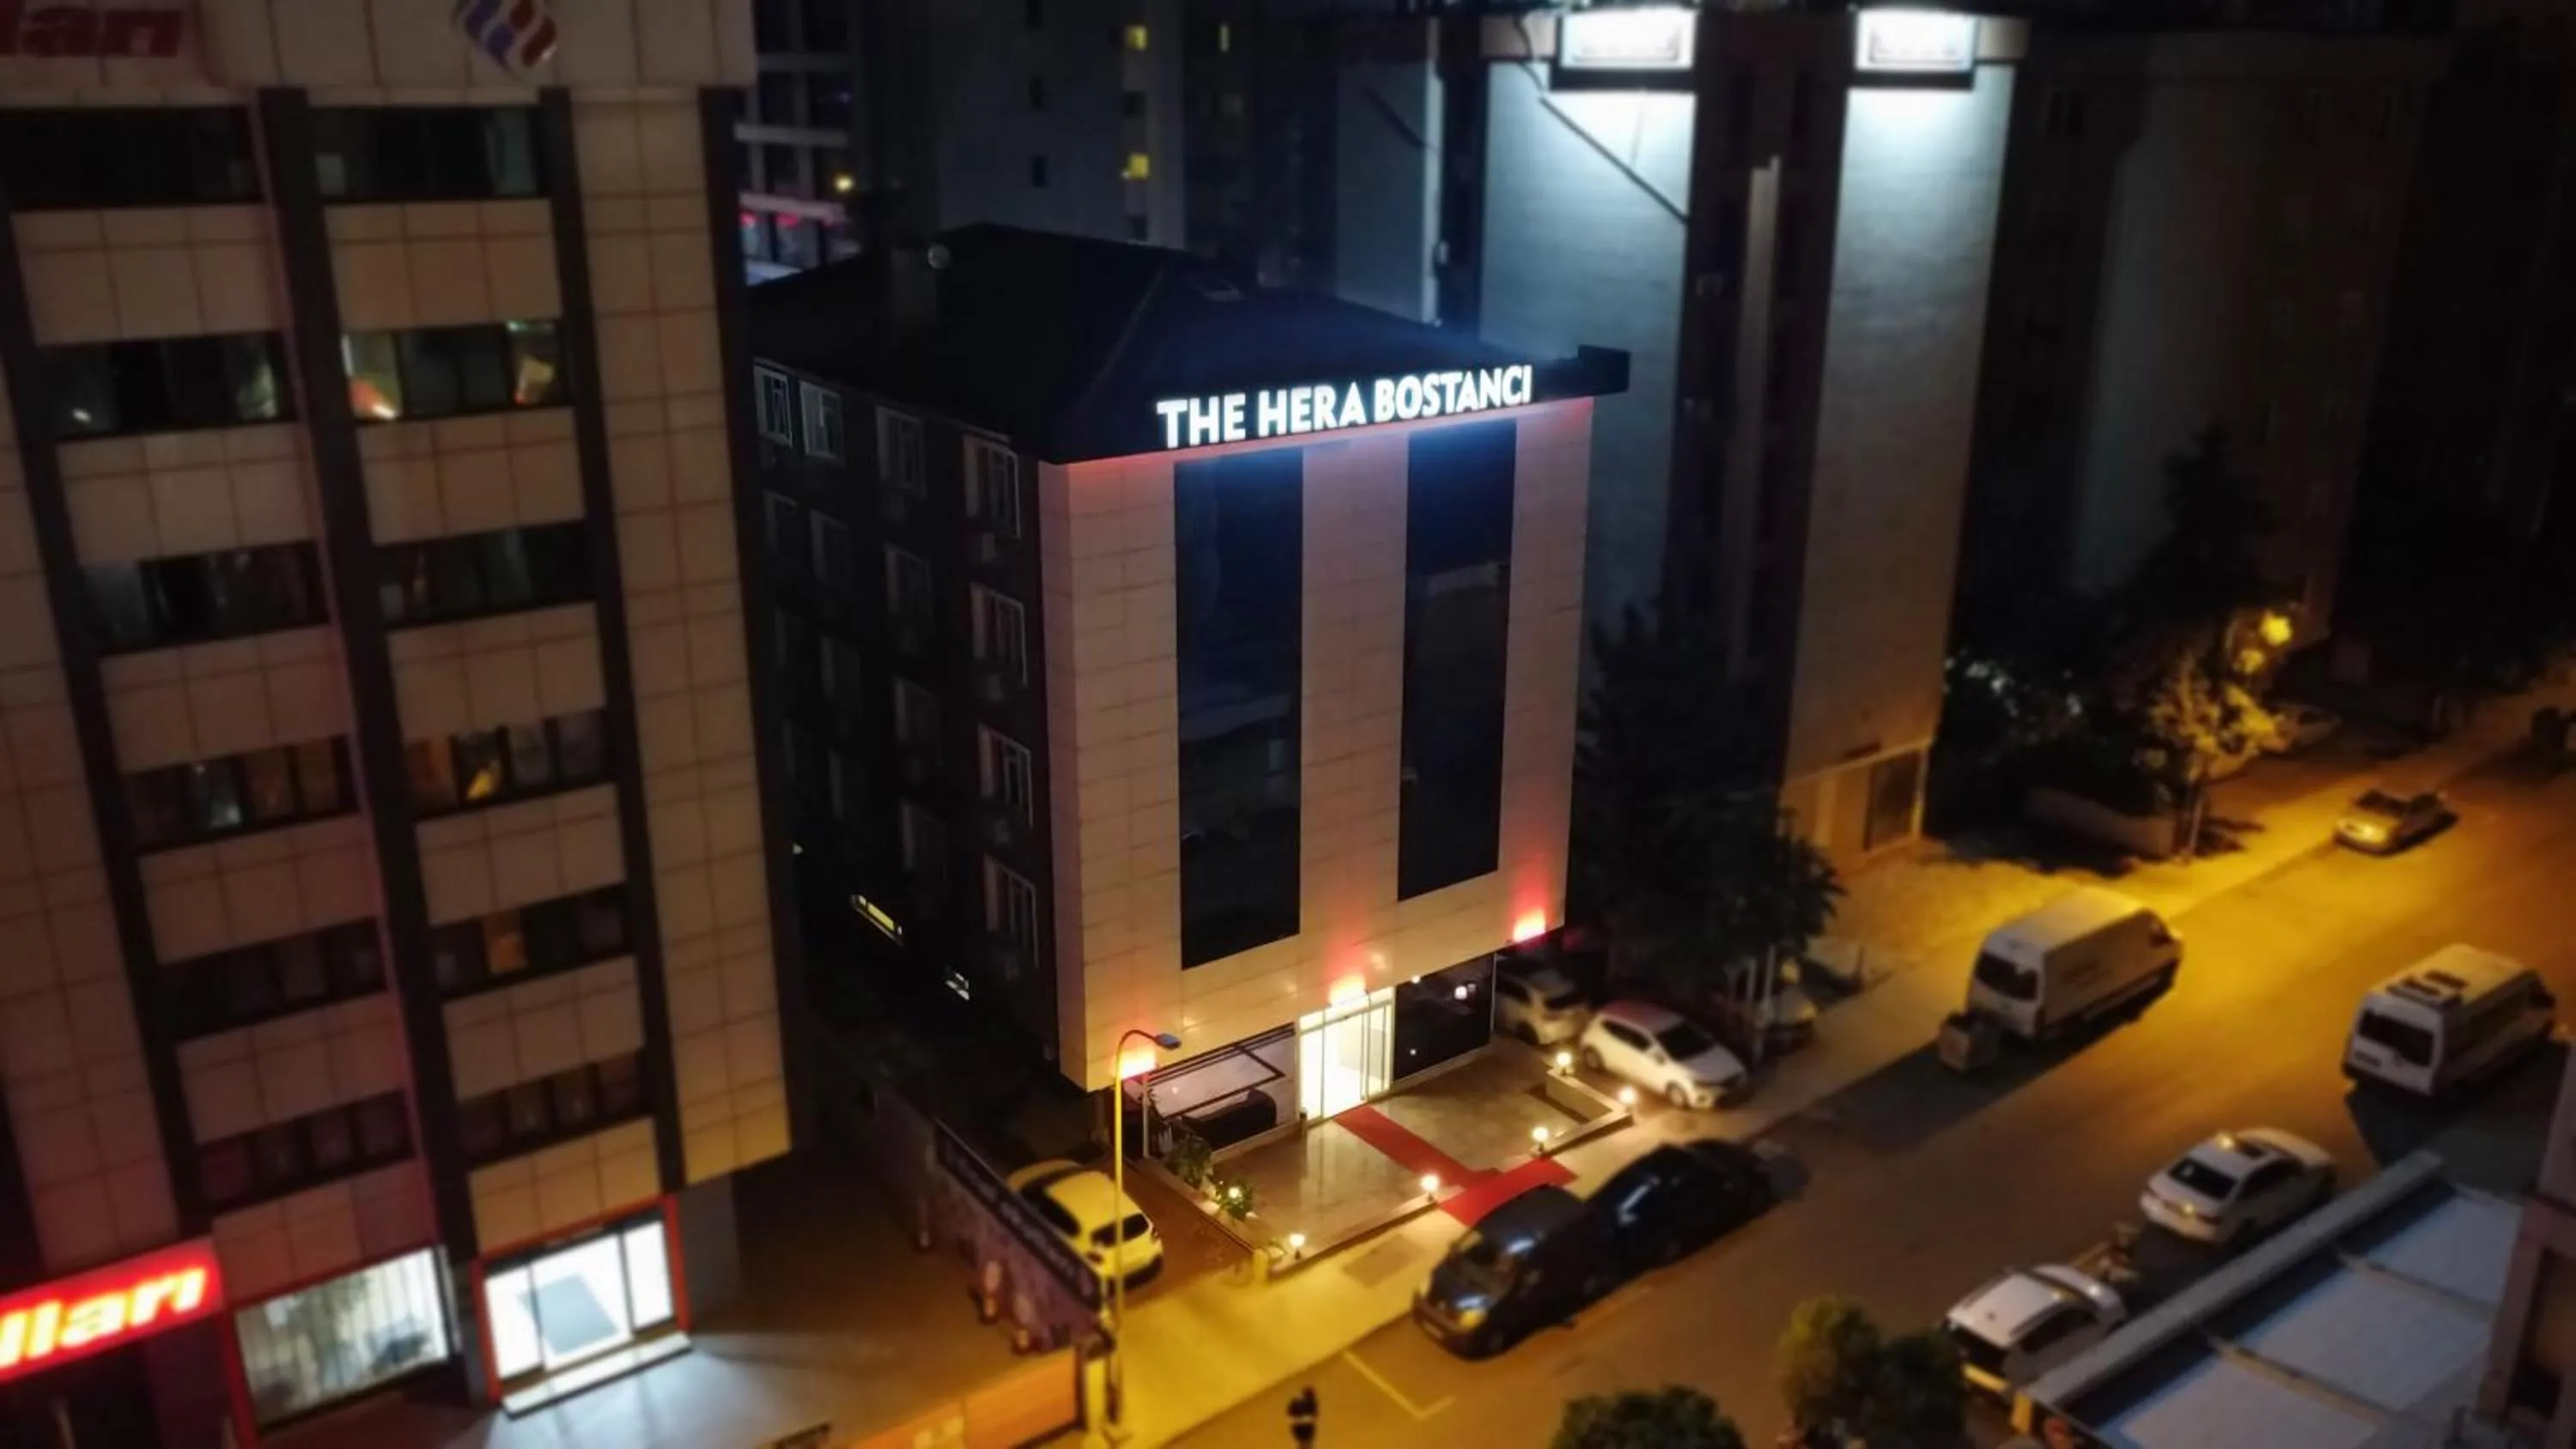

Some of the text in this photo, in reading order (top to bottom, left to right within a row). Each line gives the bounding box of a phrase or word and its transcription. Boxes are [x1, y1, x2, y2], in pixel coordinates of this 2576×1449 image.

[1156, 365, 1533, 448] THE HERA BOSTANCI
